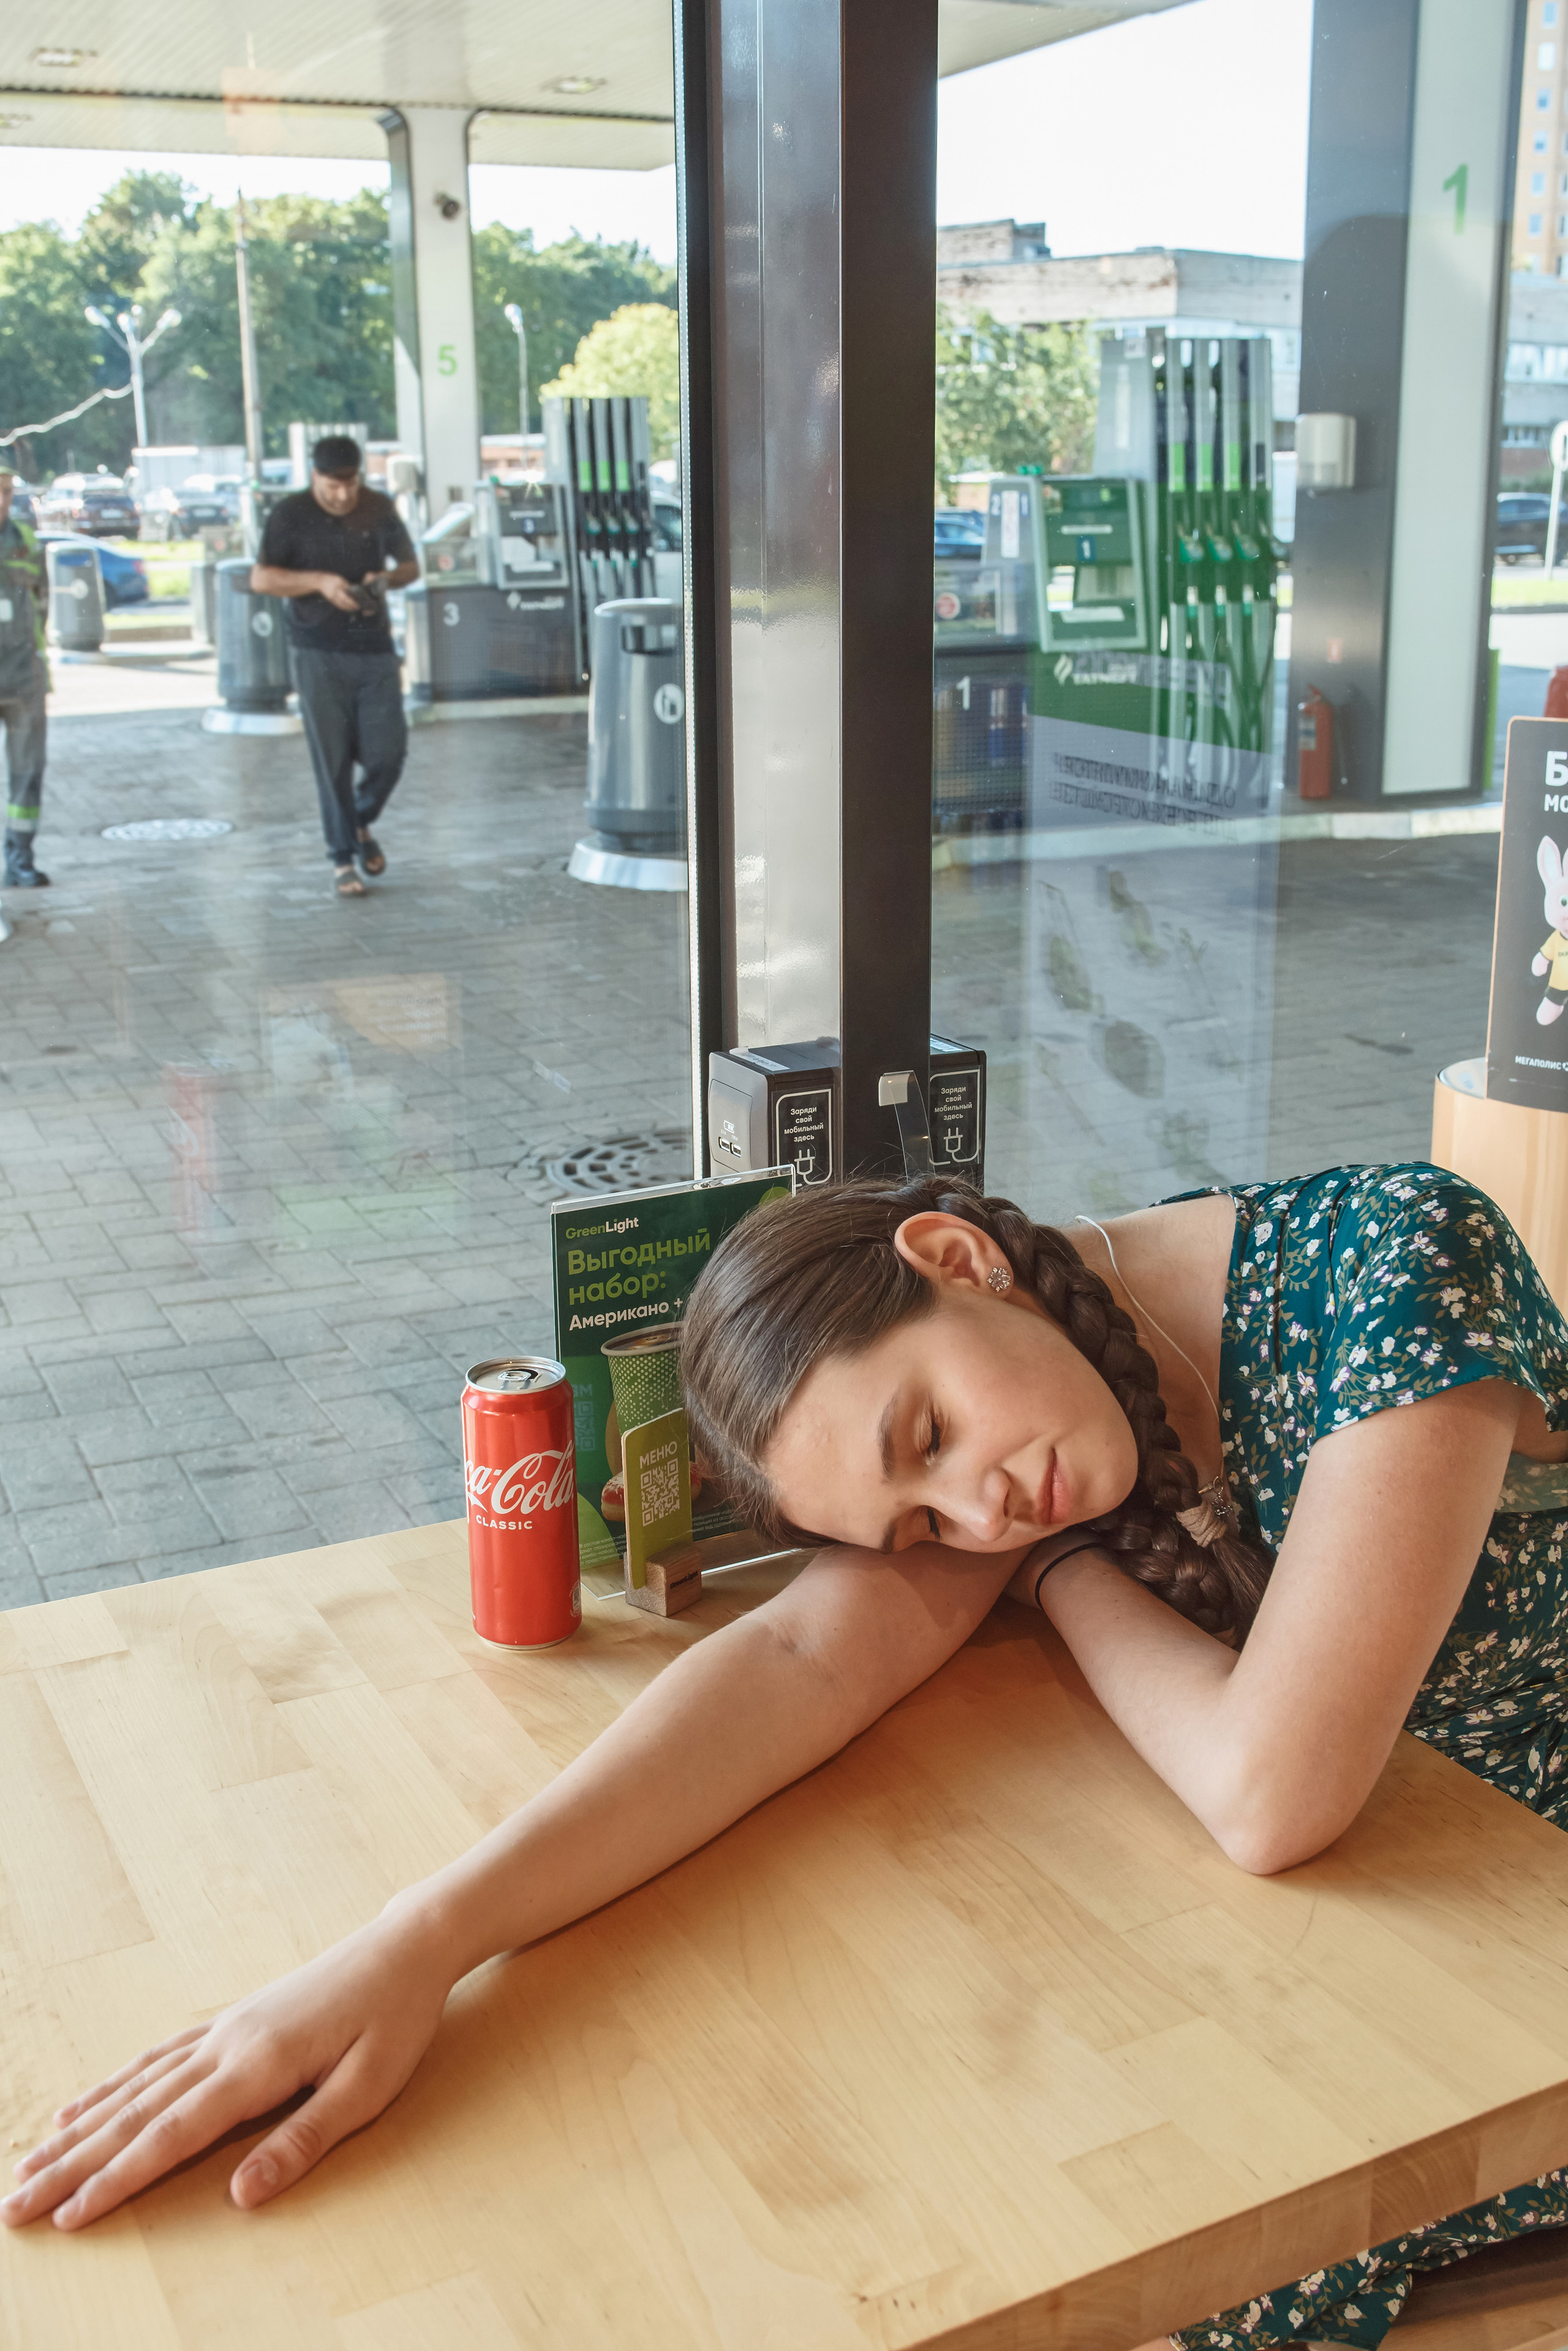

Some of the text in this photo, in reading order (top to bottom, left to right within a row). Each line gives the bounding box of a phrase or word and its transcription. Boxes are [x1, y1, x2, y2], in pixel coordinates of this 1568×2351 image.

[1442, 163, 1468, 235] 1
[439, 345, 457, 375] 5
[1082, 540, 1091, 558] 1
[443, 602, 459, 626] 3
[956, 676, 970, 710] 1
[1515, 1055, 1562, 1071] МЕГАПОЛИС
[941, 1086, 967, 1095] Заряди
[945, 1094, 962, 1103] свой
[790, 1106, 817, 1116] Заряди
[934, 1101, 973, 1113] мобильный
[784, 1122, 824, 1134] мобильный
[795, 1115, 813, 1123] свой
[565, 1217, 639, 1239] GreenLight
[568, 1228, 710, 1275] Выгодный
[569, 1272, 666, 1306] набор:
[569, 1302, 669, 1331] Американо
[639, 1441, 677, 1470] МЕНЮ
[466, 1440, 575, 1515] ca-Cola
[476, 1514, 533, 1530] CLASSIC
